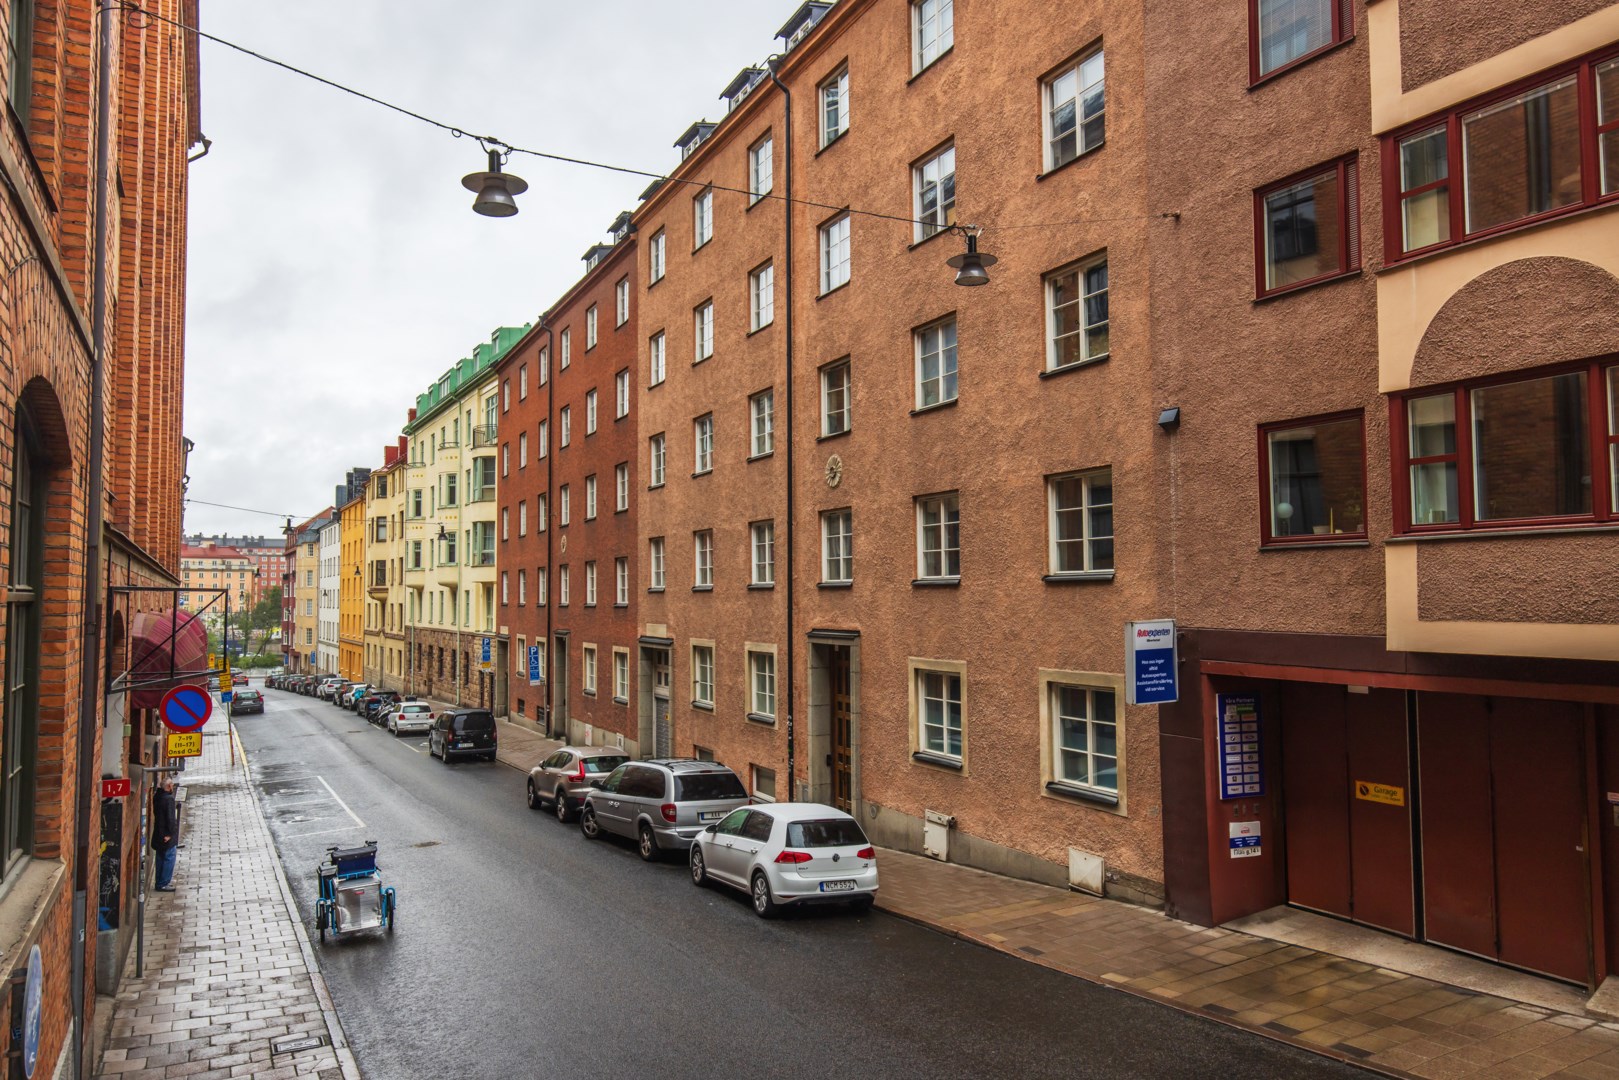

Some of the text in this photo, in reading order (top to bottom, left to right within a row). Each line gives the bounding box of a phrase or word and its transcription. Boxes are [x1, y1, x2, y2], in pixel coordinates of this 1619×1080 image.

[1136, 628, 1171, 638] Autoexperten
[107, 783, 123, 795] 1,7
[1373, 785, 1398, 797] Garage
[825, 881, 838, 889] NCM
